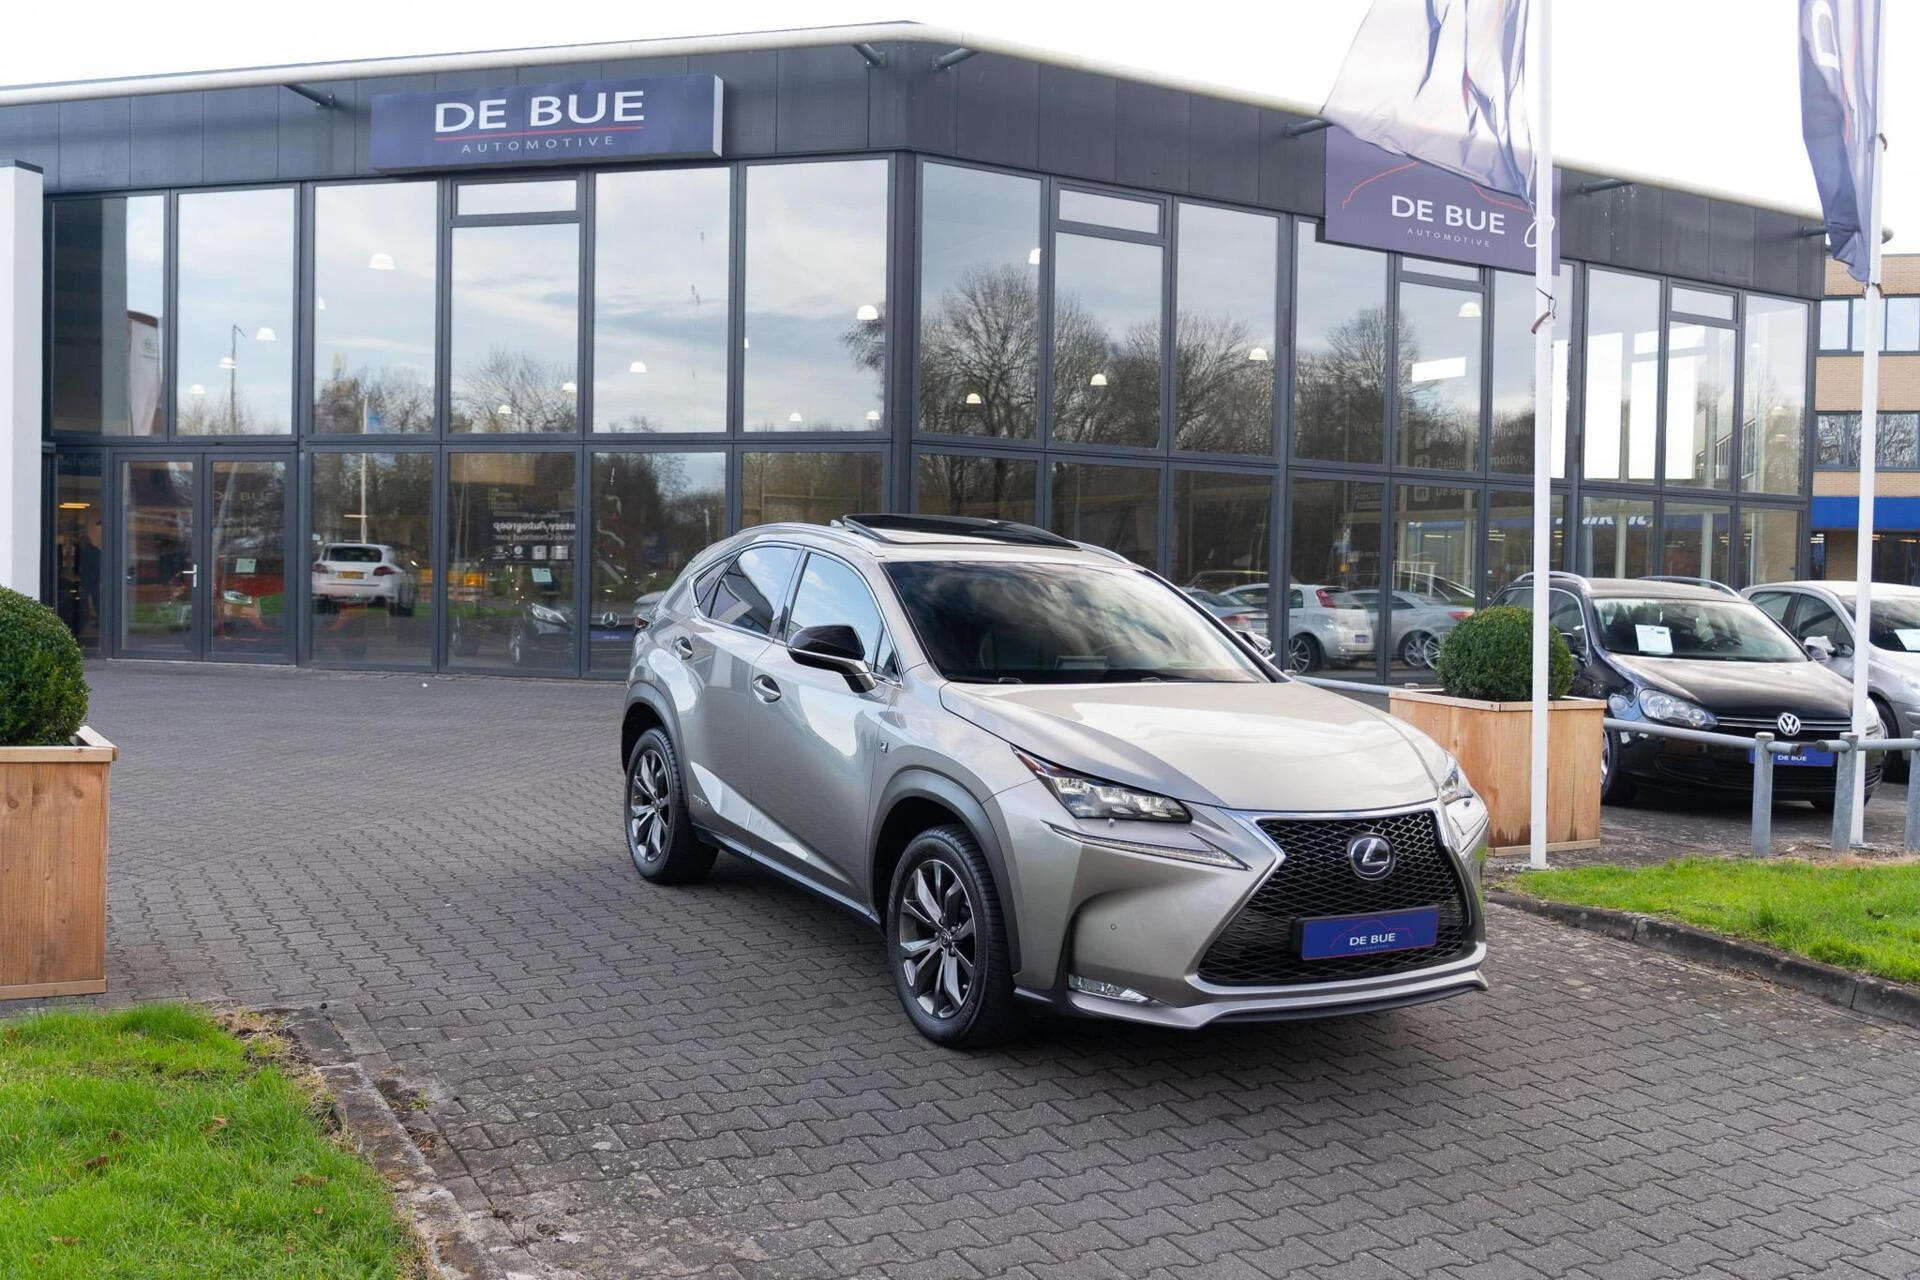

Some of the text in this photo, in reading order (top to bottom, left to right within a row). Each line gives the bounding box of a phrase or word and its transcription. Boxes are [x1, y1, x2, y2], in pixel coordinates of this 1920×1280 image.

[435, 91, 644, 132] DE BUE
[461, 135, 615, 153] AUTOMOTIVE
[1392, 195, 1505, 235] DE BUE
[1407, 227, 1490, 248] AUTOMOTIVE
[1349, 932, 1396, 946] DE BUE
